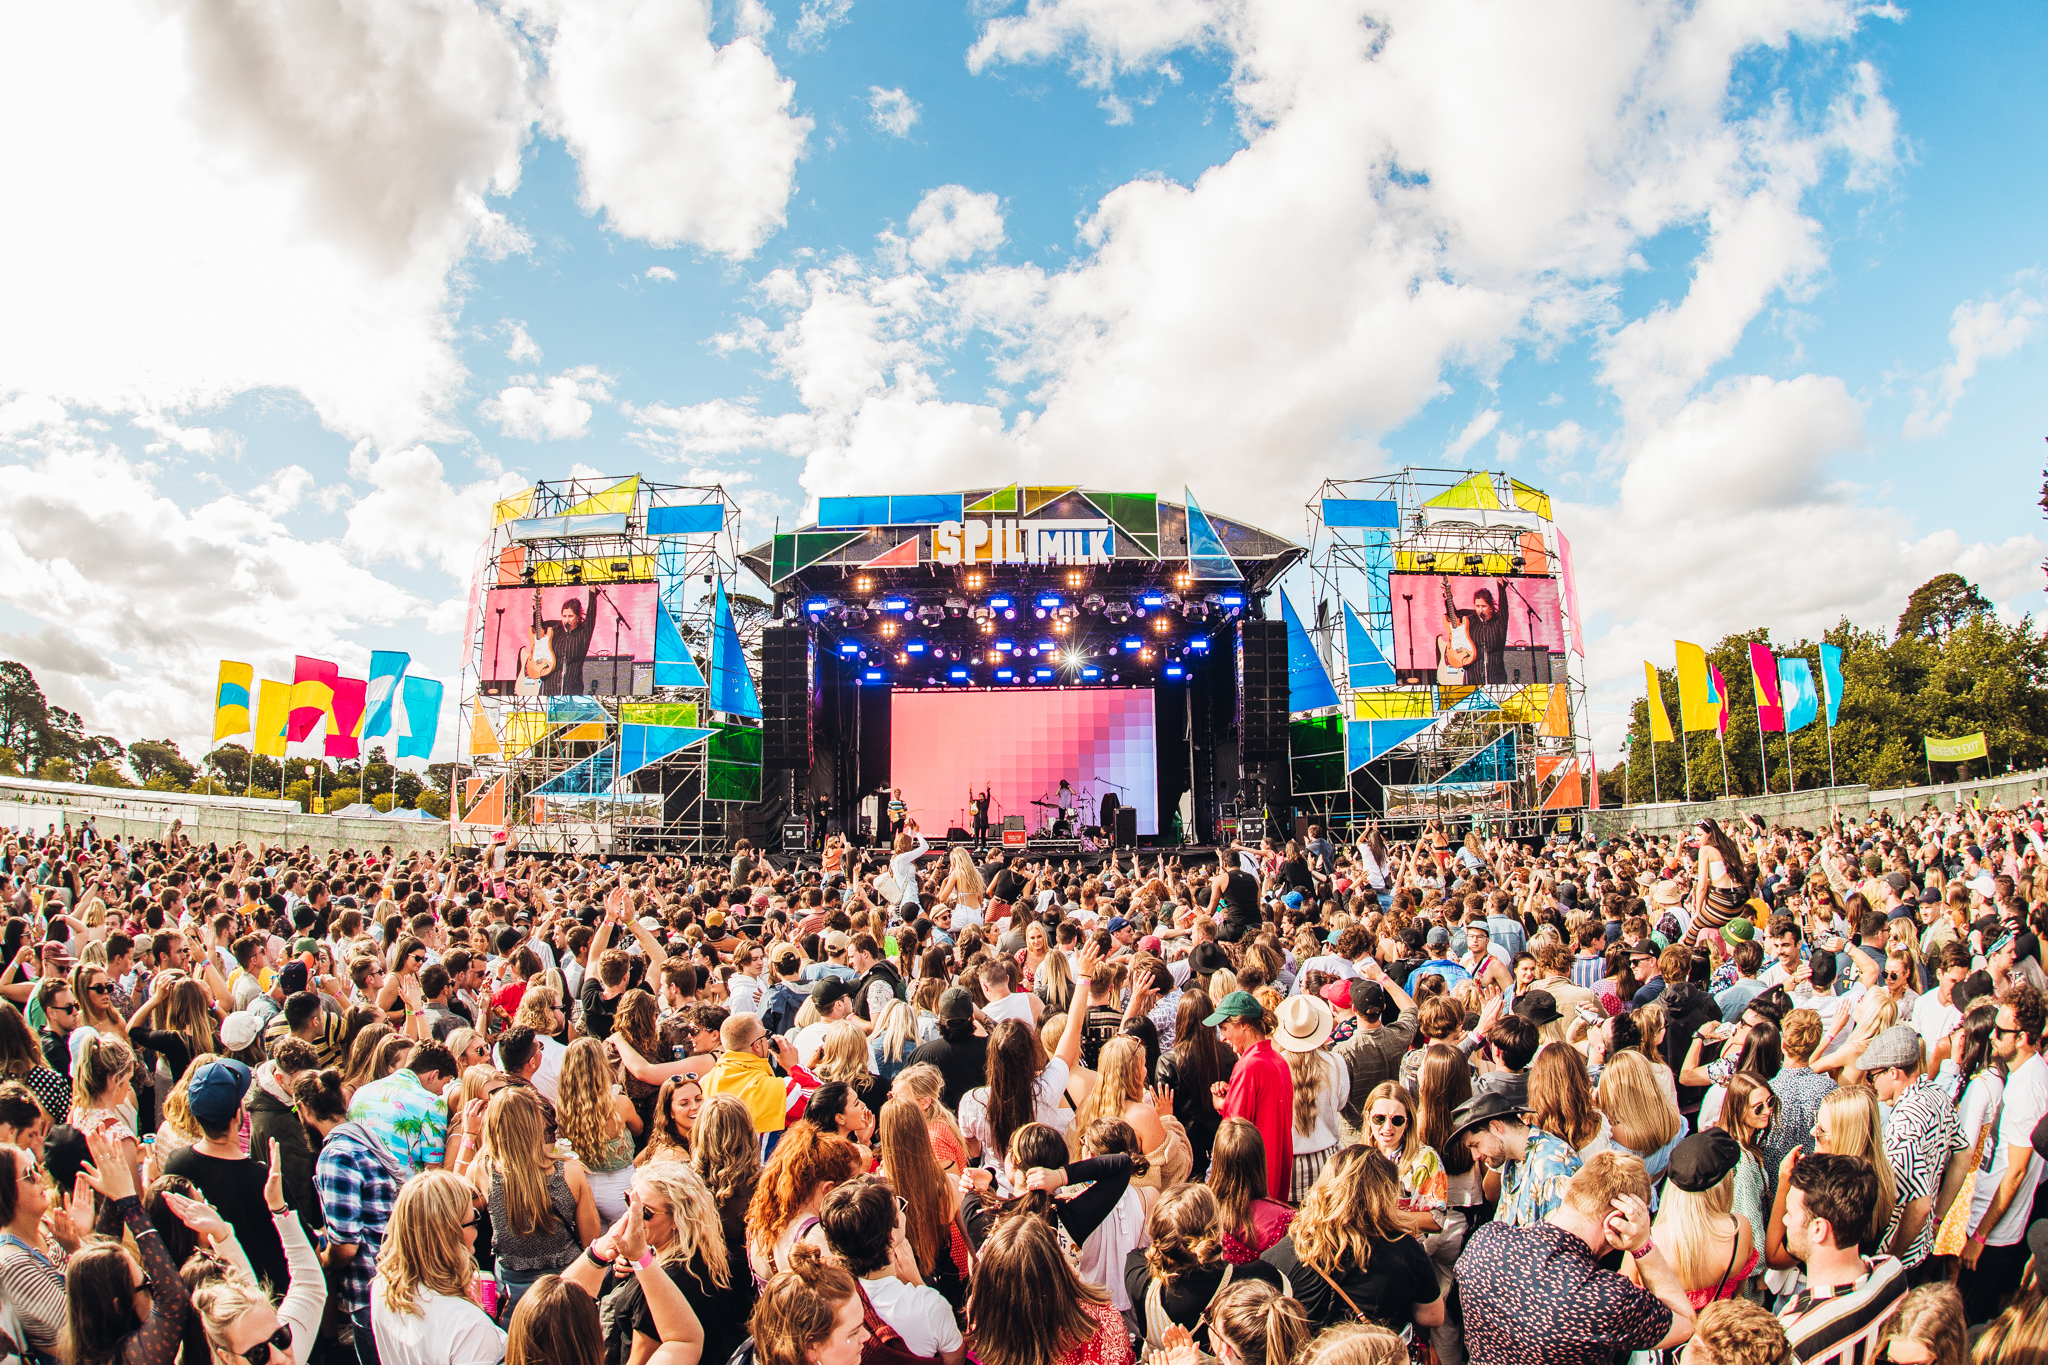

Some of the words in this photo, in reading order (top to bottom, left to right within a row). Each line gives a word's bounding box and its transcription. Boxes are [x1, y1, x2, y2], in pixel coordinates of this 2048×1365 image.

[938, 519, 1108, 566] SPILT
[1040, 531, 1110, 565] MILK
[1928, 744, 1961, 757] EMERGENCY
[1962, 740, 1979, 754] EXIT
